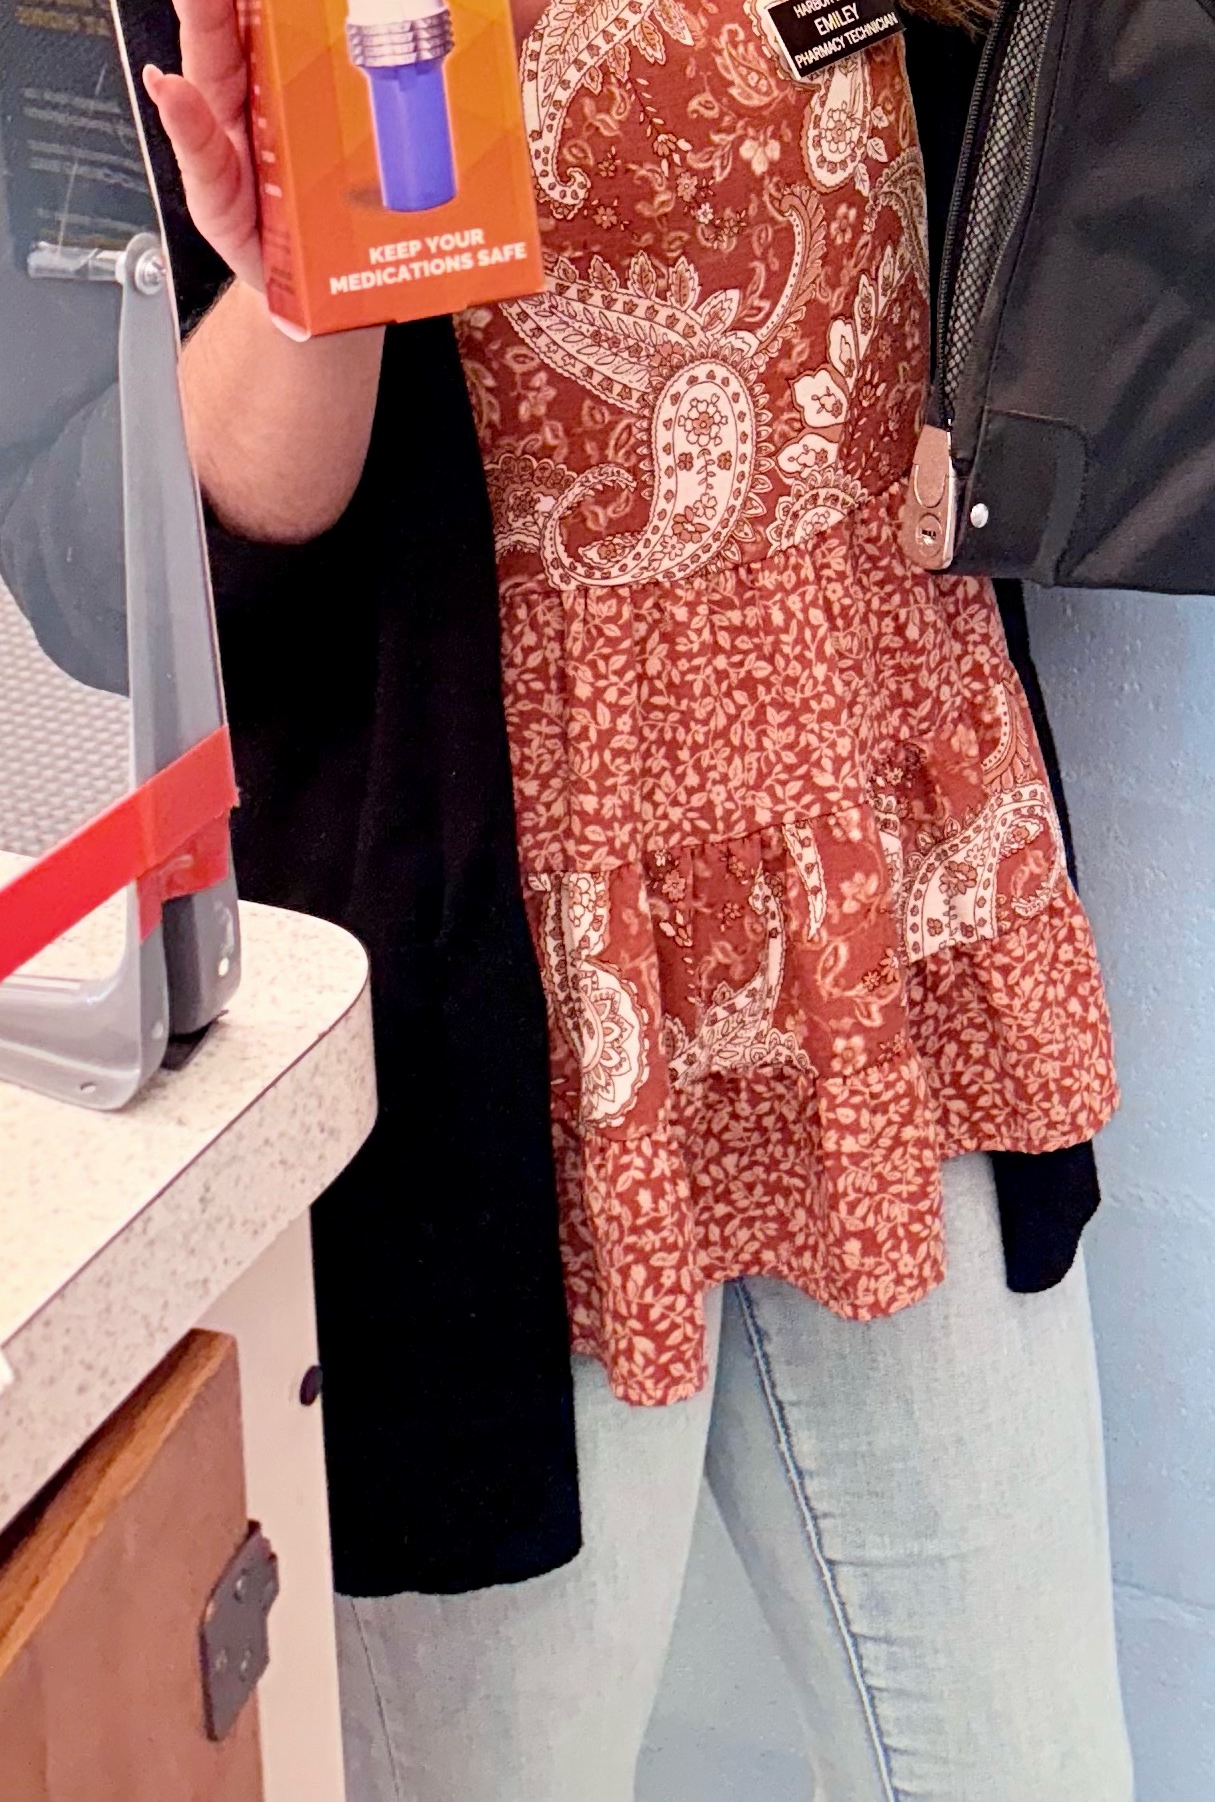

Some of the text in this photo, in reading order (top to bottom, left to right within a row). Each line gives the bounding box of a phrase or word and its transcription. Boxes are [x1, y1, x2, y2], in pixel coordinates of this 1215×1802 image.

[794, 12, 899, 69] PHARMACY TECHNICIAN
[813, 2, 860, 36] EMILEY
[328, 252, 474, 295] MEDICATIONS
[477, 241, 528, 267] SAFE
[368, 228, 485, 265] KEEP YOUR
